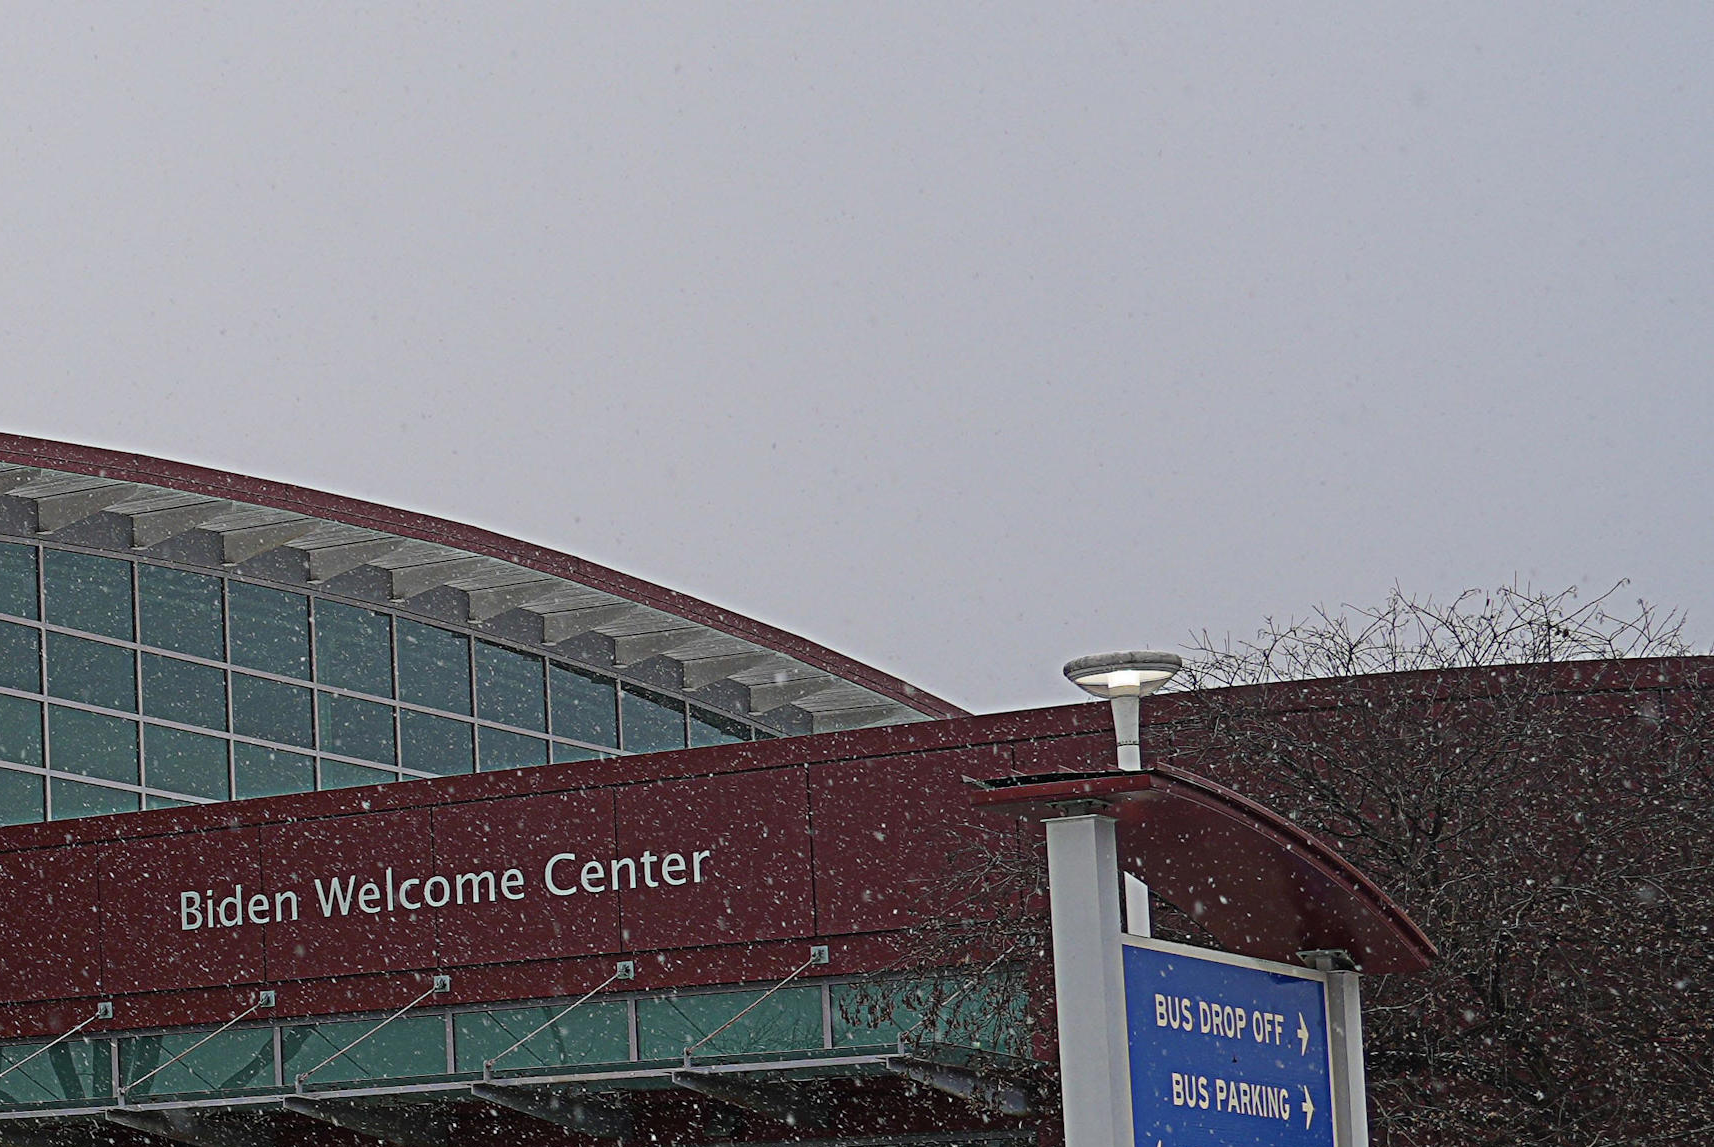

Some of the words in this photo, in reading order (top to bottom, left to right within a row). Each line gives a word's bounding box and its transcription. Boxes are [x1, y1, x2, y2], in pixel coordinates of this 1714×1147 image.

[179, 884, 299, 931] Biden
[315, 867, 526, 918] Welcome
[544, 849, 711, 896] Center
[1155, 993, 1193, 1032] BUS
[1199, 1001, 1247, 1040] DROP
[1252, 1010, 1285, 1046] OFF
[1171, 1072, 1210, 1110] BUS
[1215, 1079, 1291, 1121] PARKING
